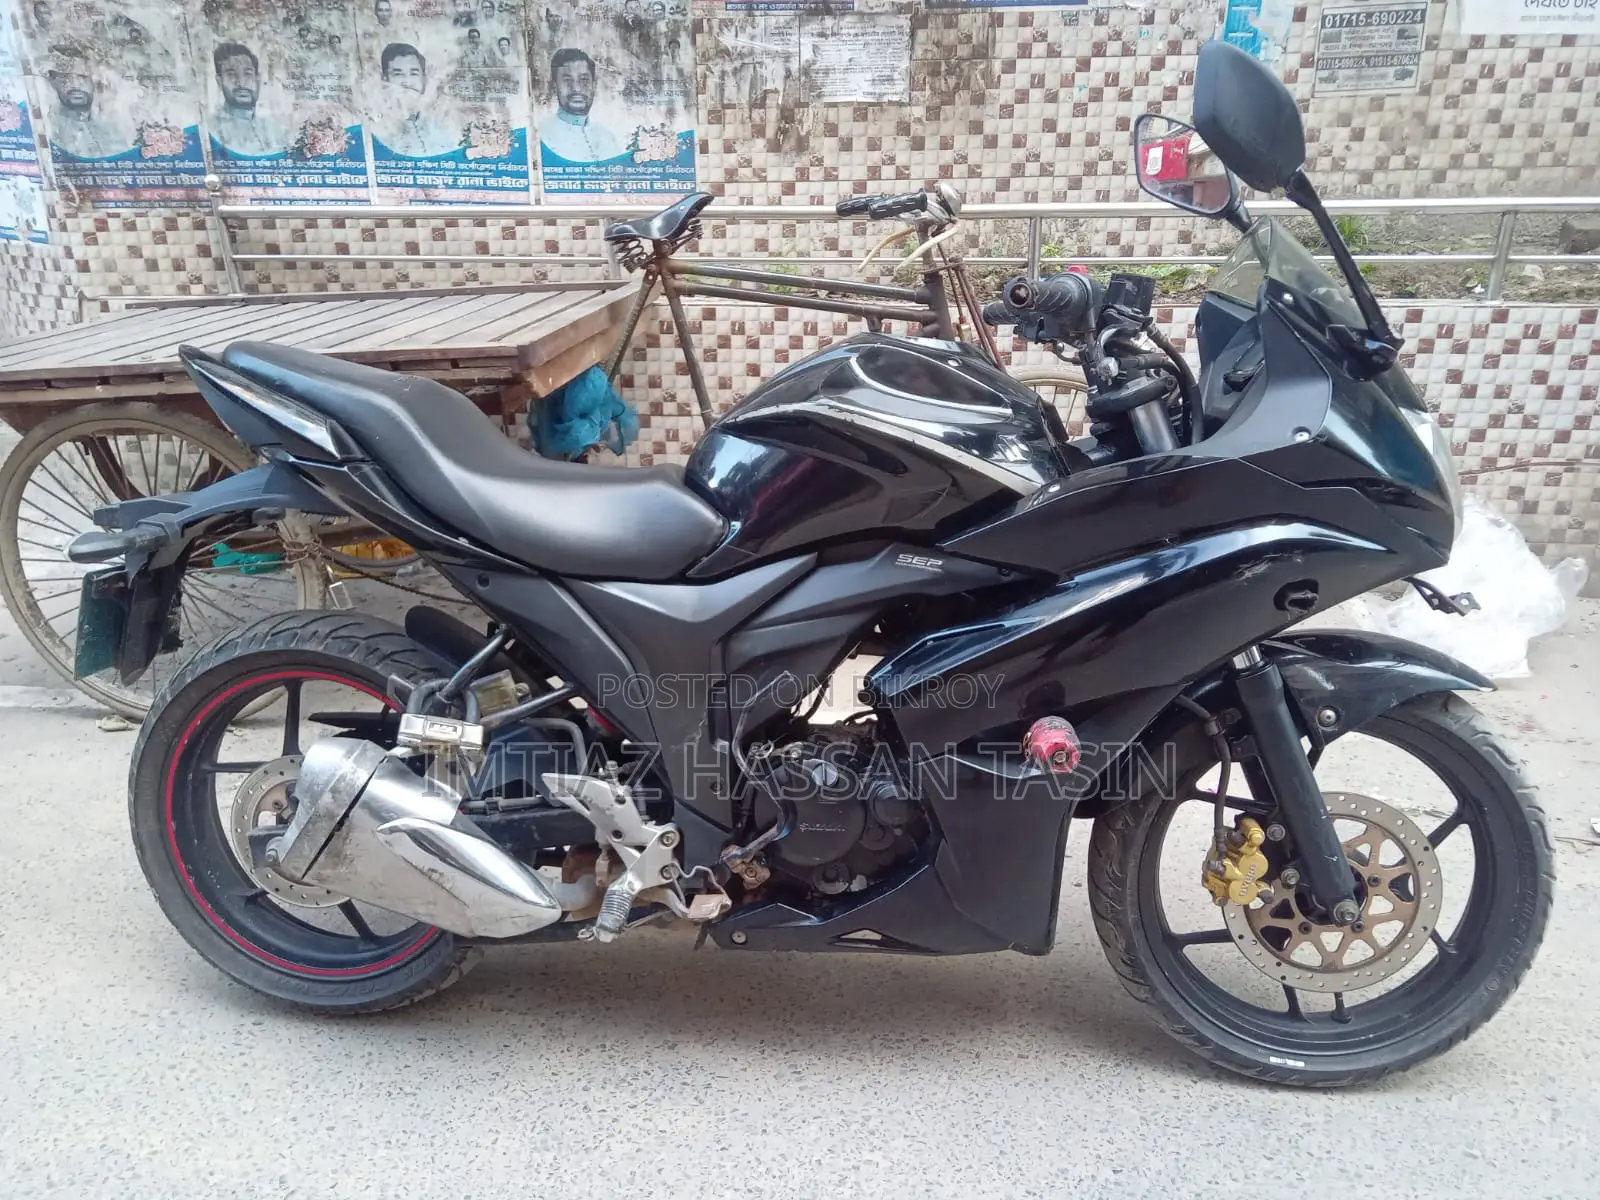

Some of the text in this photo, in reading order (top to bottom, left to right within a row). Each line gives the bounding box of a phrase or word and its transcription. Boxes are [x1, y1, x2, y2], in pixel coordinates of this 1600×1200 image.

[1325, 9, 1422, 28] 01715-690224
[297, 174, 323, 187] রানা
[457, 176, 484, 188] রানা
[624, 180, 651, 193] রানা
[897, 553, 943, 566] SEP
